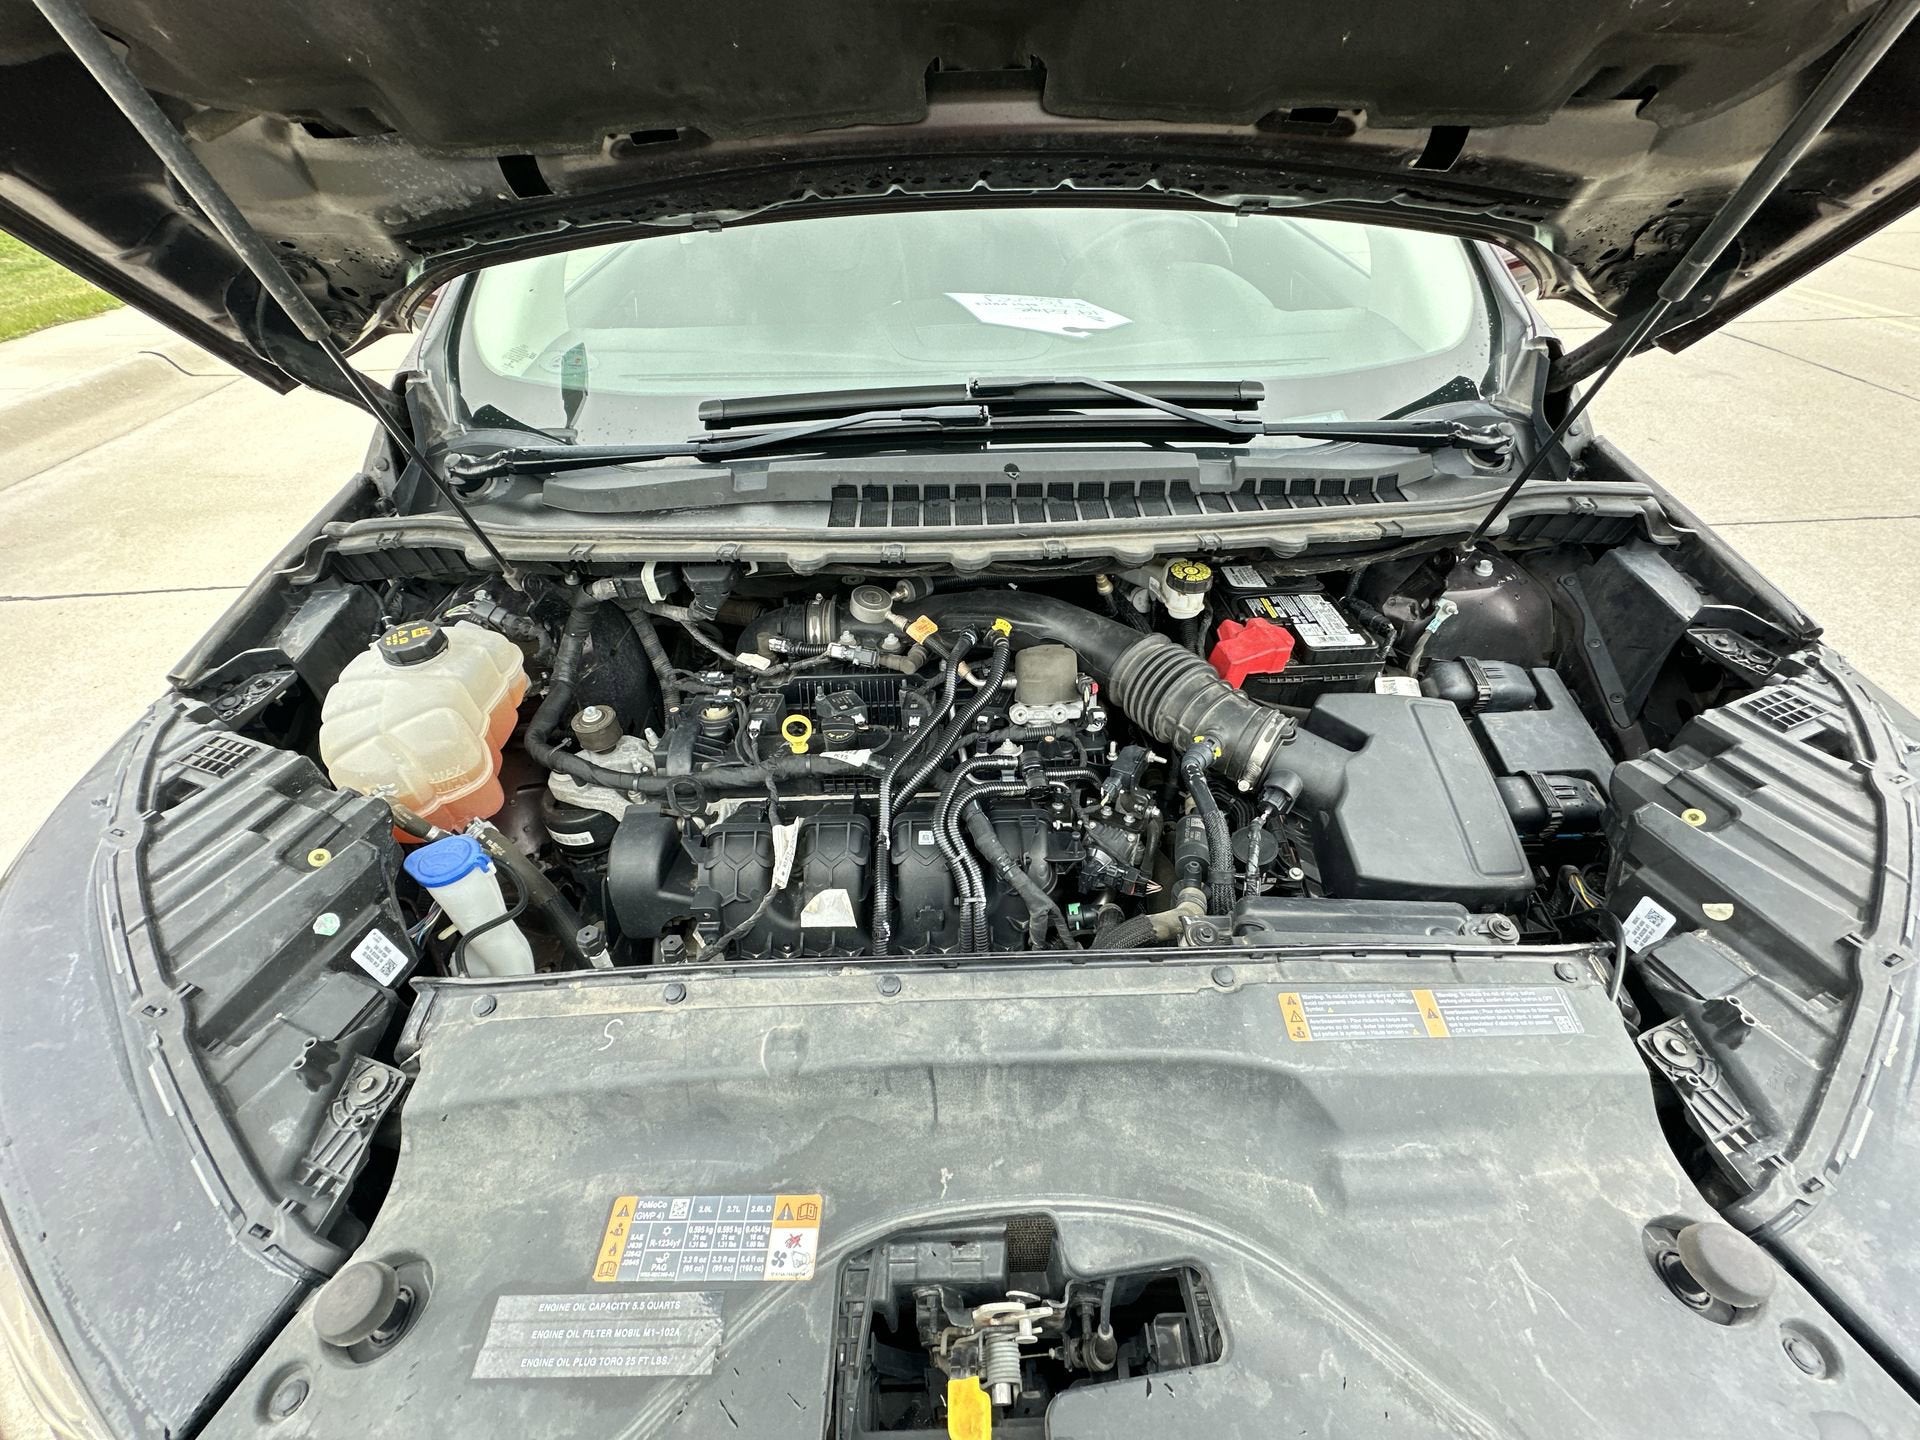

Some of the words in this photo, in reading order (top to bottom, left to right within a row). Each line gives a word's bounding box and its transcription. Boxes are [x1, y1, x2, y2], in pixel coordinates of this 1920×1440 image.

[638, 1200, 667, 1209] FoMoCo
[649, 1239, 681, 1248] R-1234yf
[538, 1302, 570, 1312] ENGINE
[573, 1302, 586, 1311] OIL
[588, 1301, 630, 1311] CAPACITY
[631, 1301, 645, 1310] 5.5
[647, 1301, 681, 1310] QUARTS
[531, 1329, 564, 1339] ENGINE
[566, 1329, 580, 1338] OIL
[582, 1328, 612, 1338] FILTER
[614, 1328, 641, 1337] MOBIL
[642, 1327, 680, 1337] M1-102A
[520, 1358, 554, 1367] ENGINE
[556, 1357, 570, 1367] OIL
[572, 1357, 596, 1366] PLUG
[625, 1356, 636, 1365] 25
[638, 1356, 649, 1365] FT
